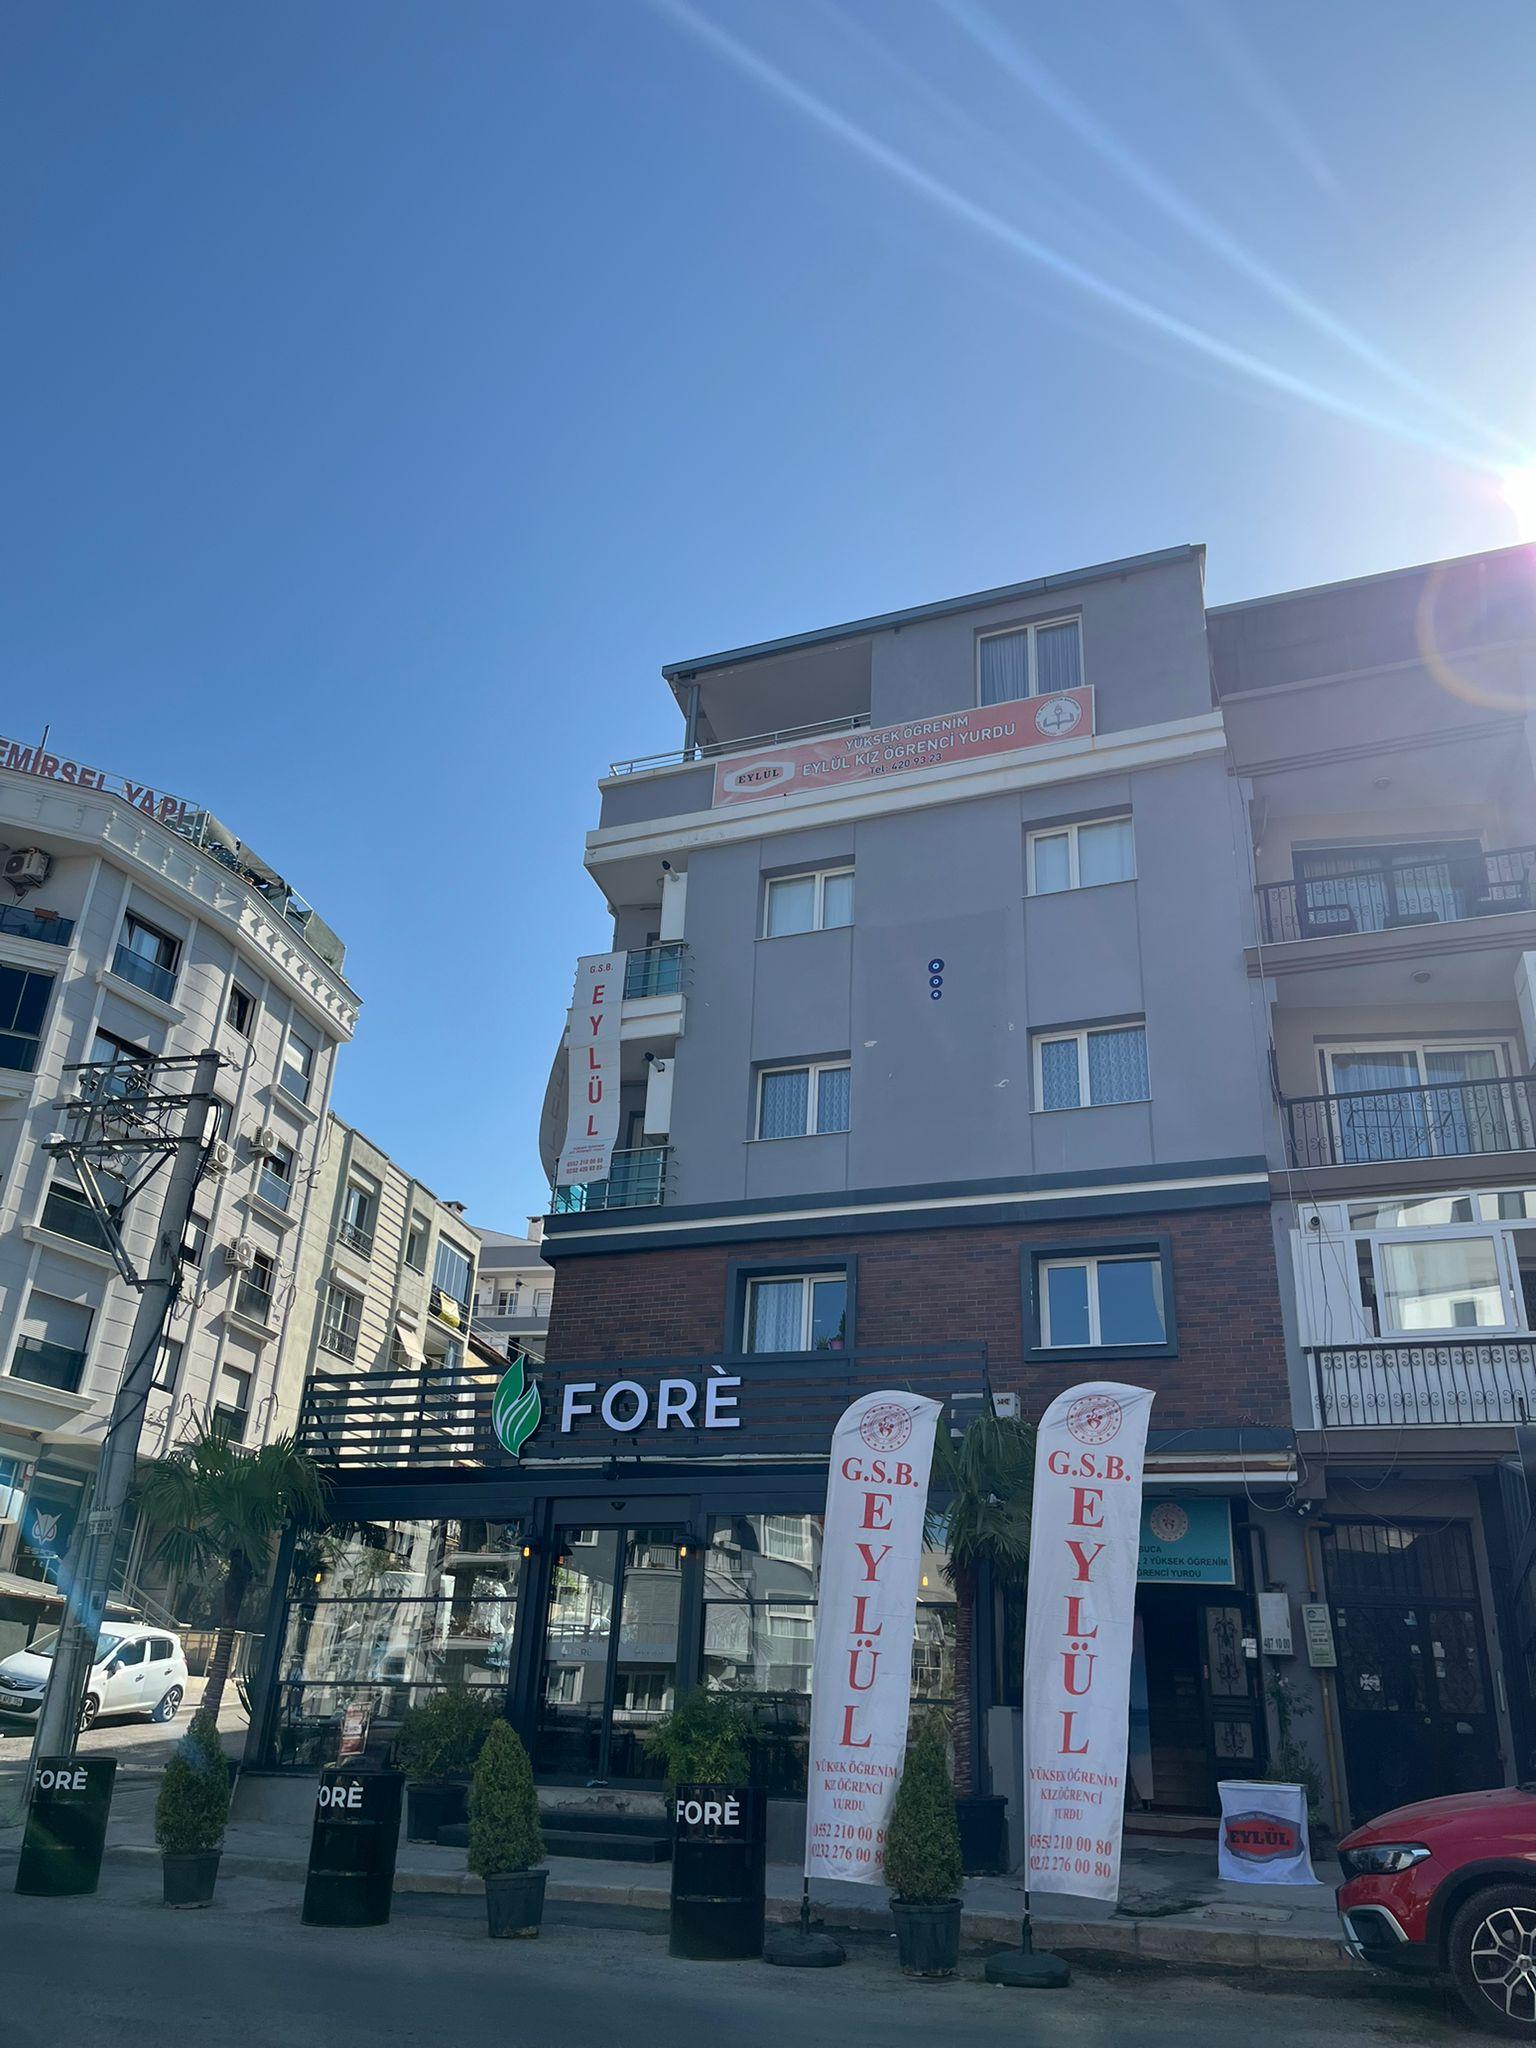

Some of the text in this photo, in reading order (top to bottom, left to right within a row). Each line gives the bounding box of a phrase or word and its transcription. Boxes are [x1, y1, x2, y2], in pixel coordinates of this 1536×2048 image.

[845, 715, 969, 750] YÜKSEK ÖĞRENİM
[802, 722, 1016, 777] EYLÜL KIZ ÖĞRENCİ YURDU
[891, 759, 910, 771] 420
[913, 755, 926, 767] 93
[929, 752, 943, 764] 23
[738, 769, 780, 785] EYLÜL
[125, 782, 187, 827] YAPI
[590, 963, 614, 974] G.S.B.
[586, 984, 605, 1137] EYLÜL
[560, 1365, 742, 1433] FORÈ
[841, 1456, 919, 1488] G.S.B.
[1047, 1449, 1132, 1483] G.S.B.
[1171, 1570, 1202, 1578] YURDU
[839, 1491, 894, 1749] EYLÜL
[1058, 1486, 1107, 1756] EYLÜL
[676, 1795, 740, 1825] FORÈ
[834, 1824, 855, 1839] 210
[857, 1826, 872, 1841] 00
[1053, 1835, 1072, 1850] 210
[1076, 1836, 1091, 1852] 00
[1096, 1840, 1112, 1856] 80
[1229, 1827, 1290, 1846] EYLÜL
[832, 1844, 852, 1860] 276
[856, 1847, 871, 1863] 00
[1052, 1857, 1071, 1872] 276
[1074, 1858, 1090, 1874] 00
[1095, 1861, 1111, 1878] 80
